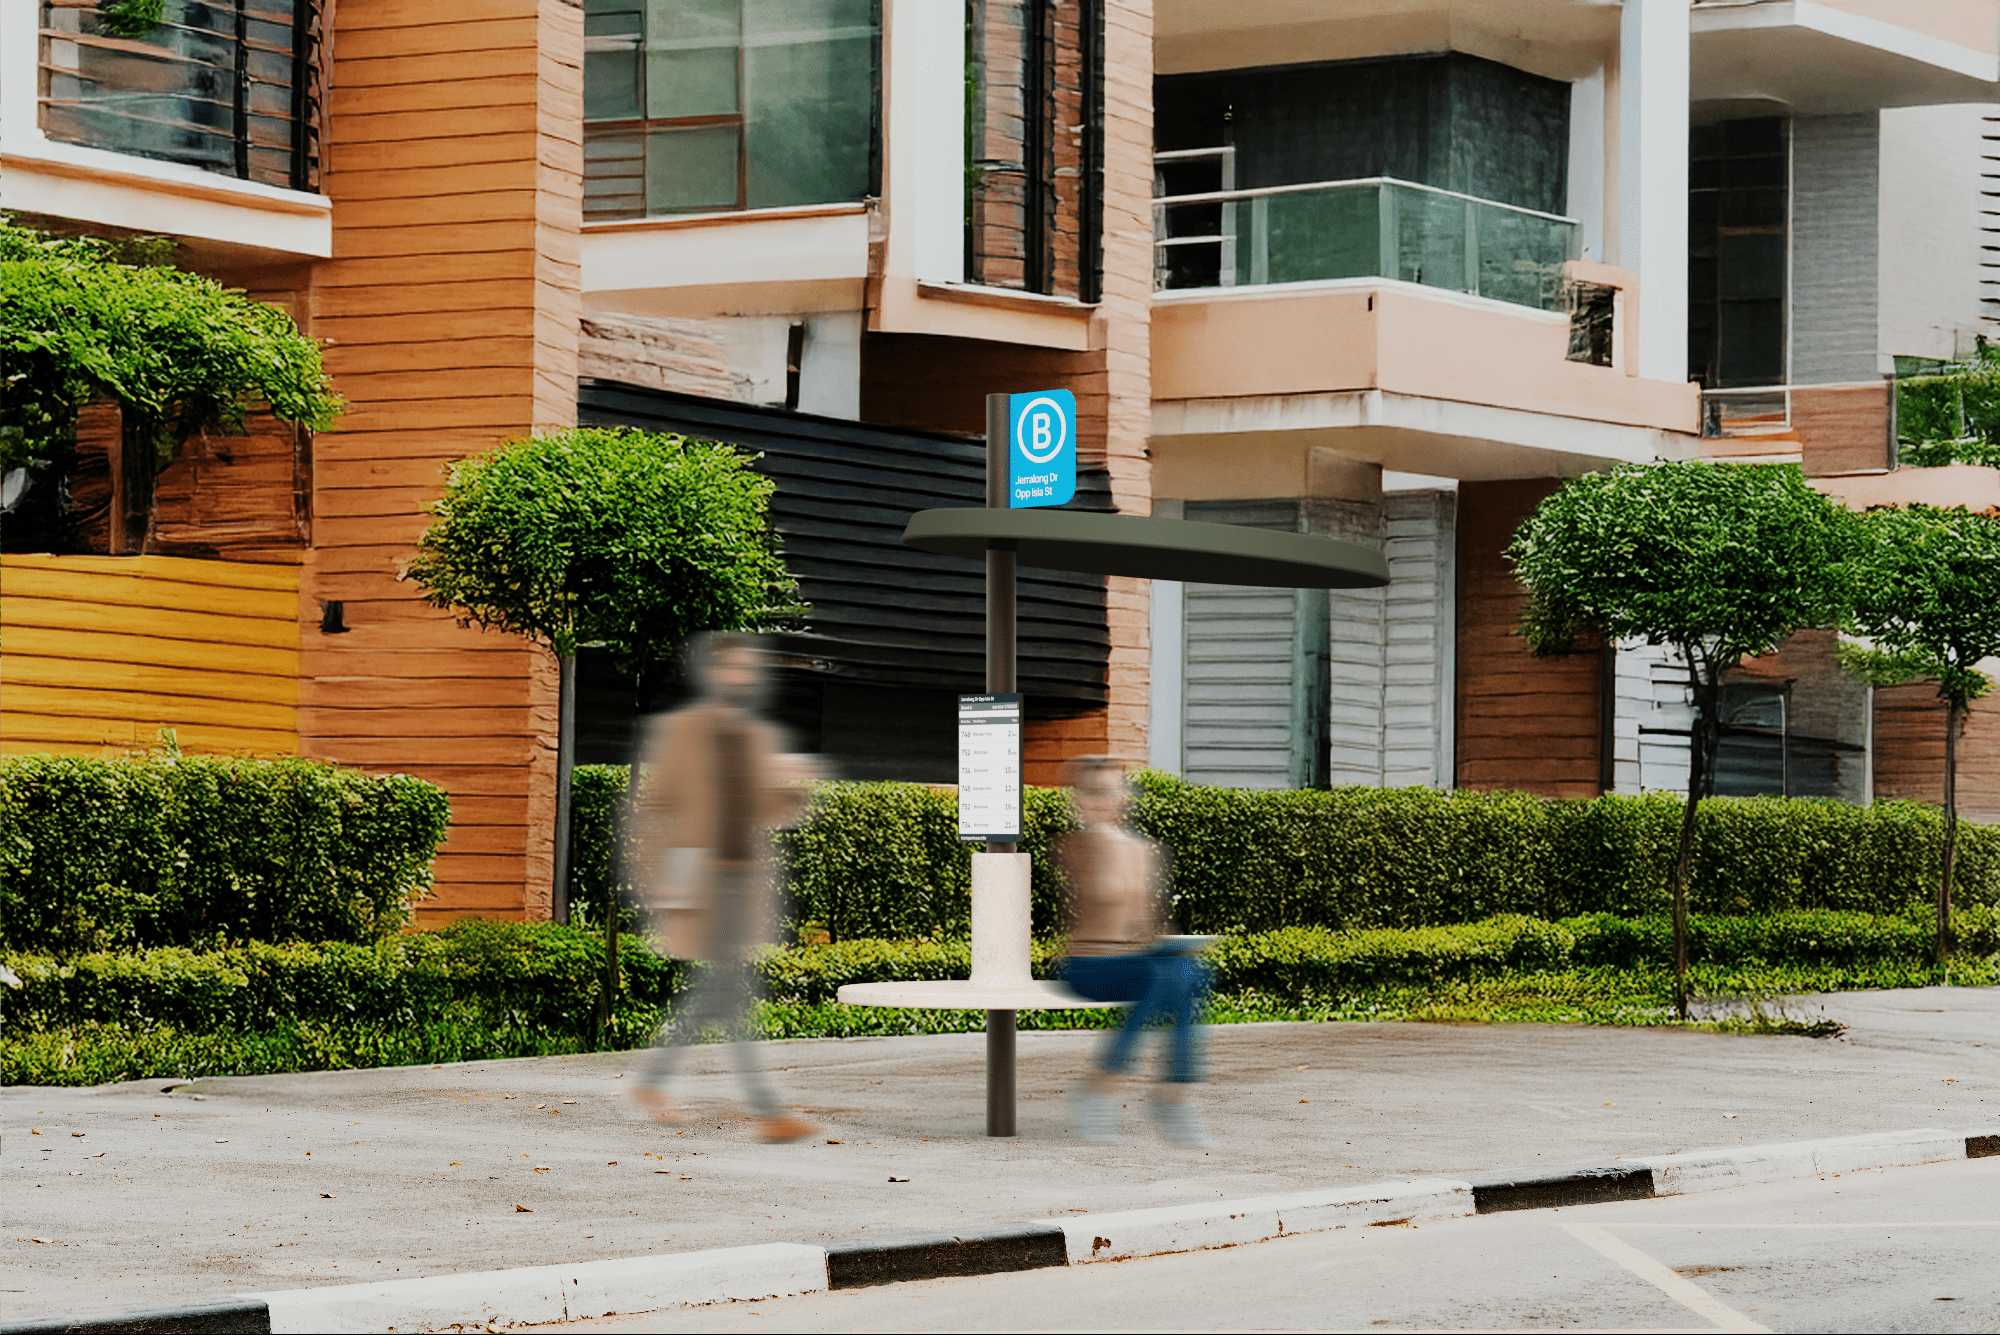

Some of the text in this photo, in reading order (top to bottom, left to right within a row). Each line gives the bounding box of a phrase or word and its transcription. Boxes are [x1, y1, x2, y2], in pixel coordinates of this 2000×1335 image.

[1032, 412, 1052, 450] B
[1050, 472, 1058, 482] Dr
[1015, 489, 1031, 501] Opp
[1044, 486, 1053, 496] St
